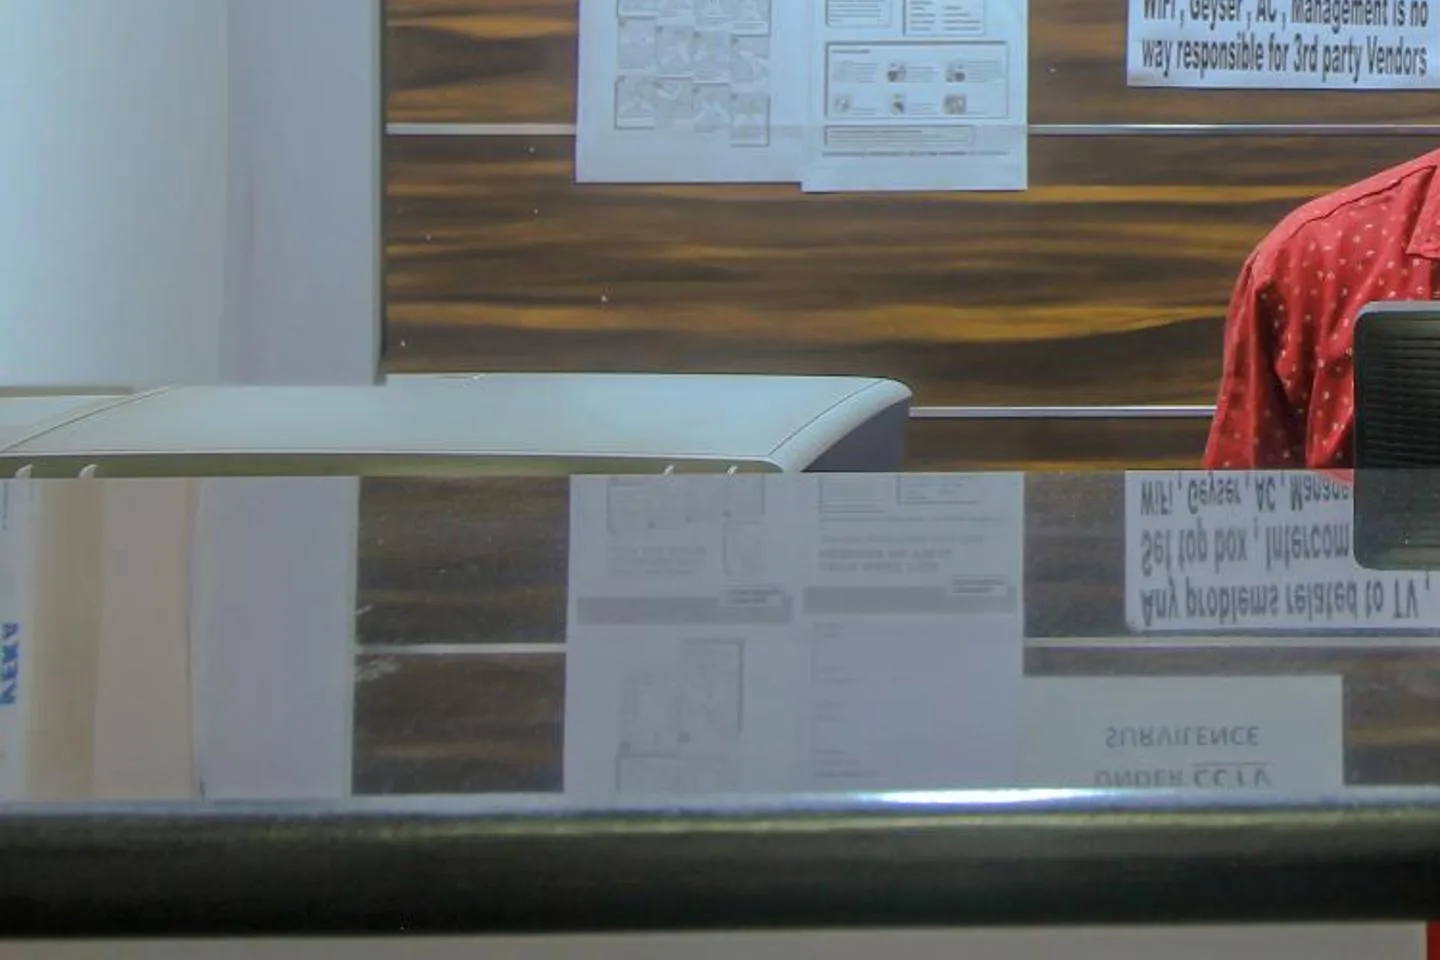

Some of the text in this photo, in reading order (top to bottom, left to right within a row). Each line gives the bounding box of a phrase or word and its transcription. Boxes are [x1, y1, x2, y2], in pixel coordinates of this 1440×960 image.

[1409, 0, 1428, 28] no
[1142, 32, 1428, 83] way responsible for 3rd party Vendors
